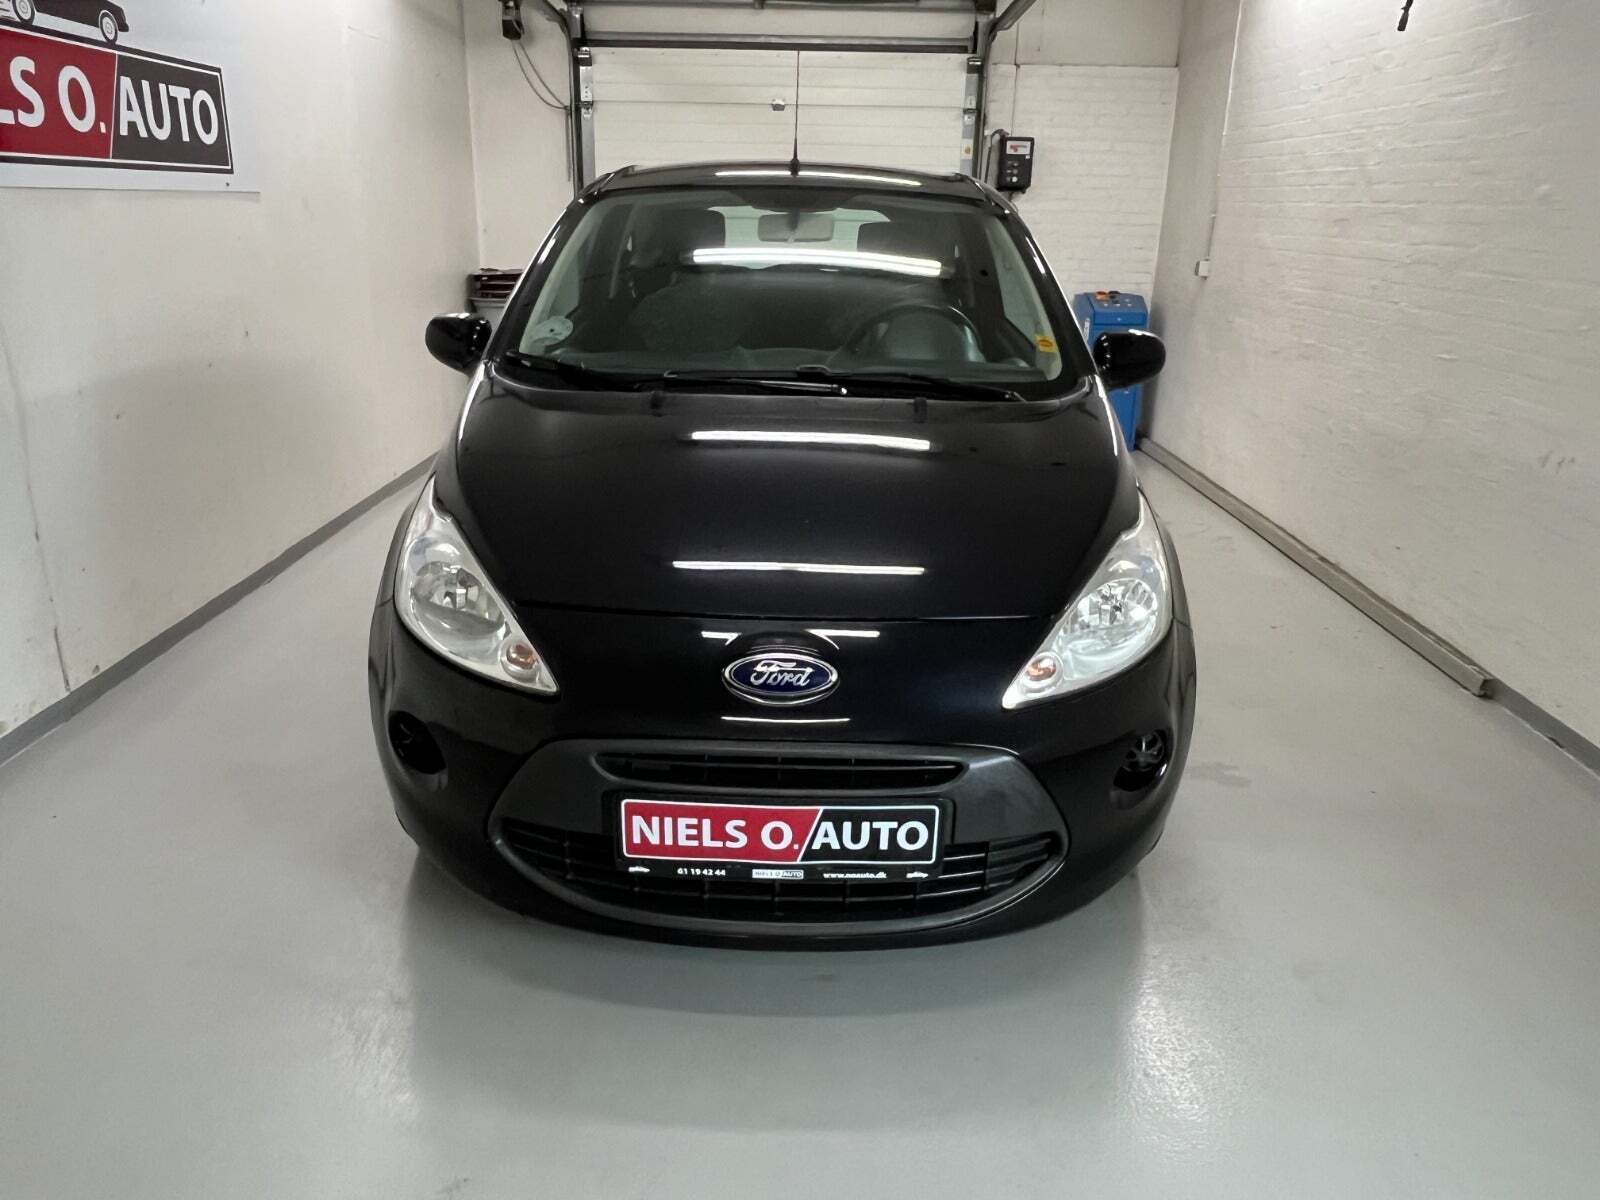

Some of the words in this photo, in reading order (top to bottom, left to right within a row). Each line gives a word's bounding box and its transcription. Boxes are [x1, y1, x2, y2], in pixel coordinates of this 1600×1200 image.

[58, 65, 106, 133] O.
[119, 75, 219, 145] AUTO
[750, 660, 815, 687] Ford
[632, 815, 748, 848] NIELS
[760, 820, 799, 850] O.
[811, 821, 929, 851] AUTO
